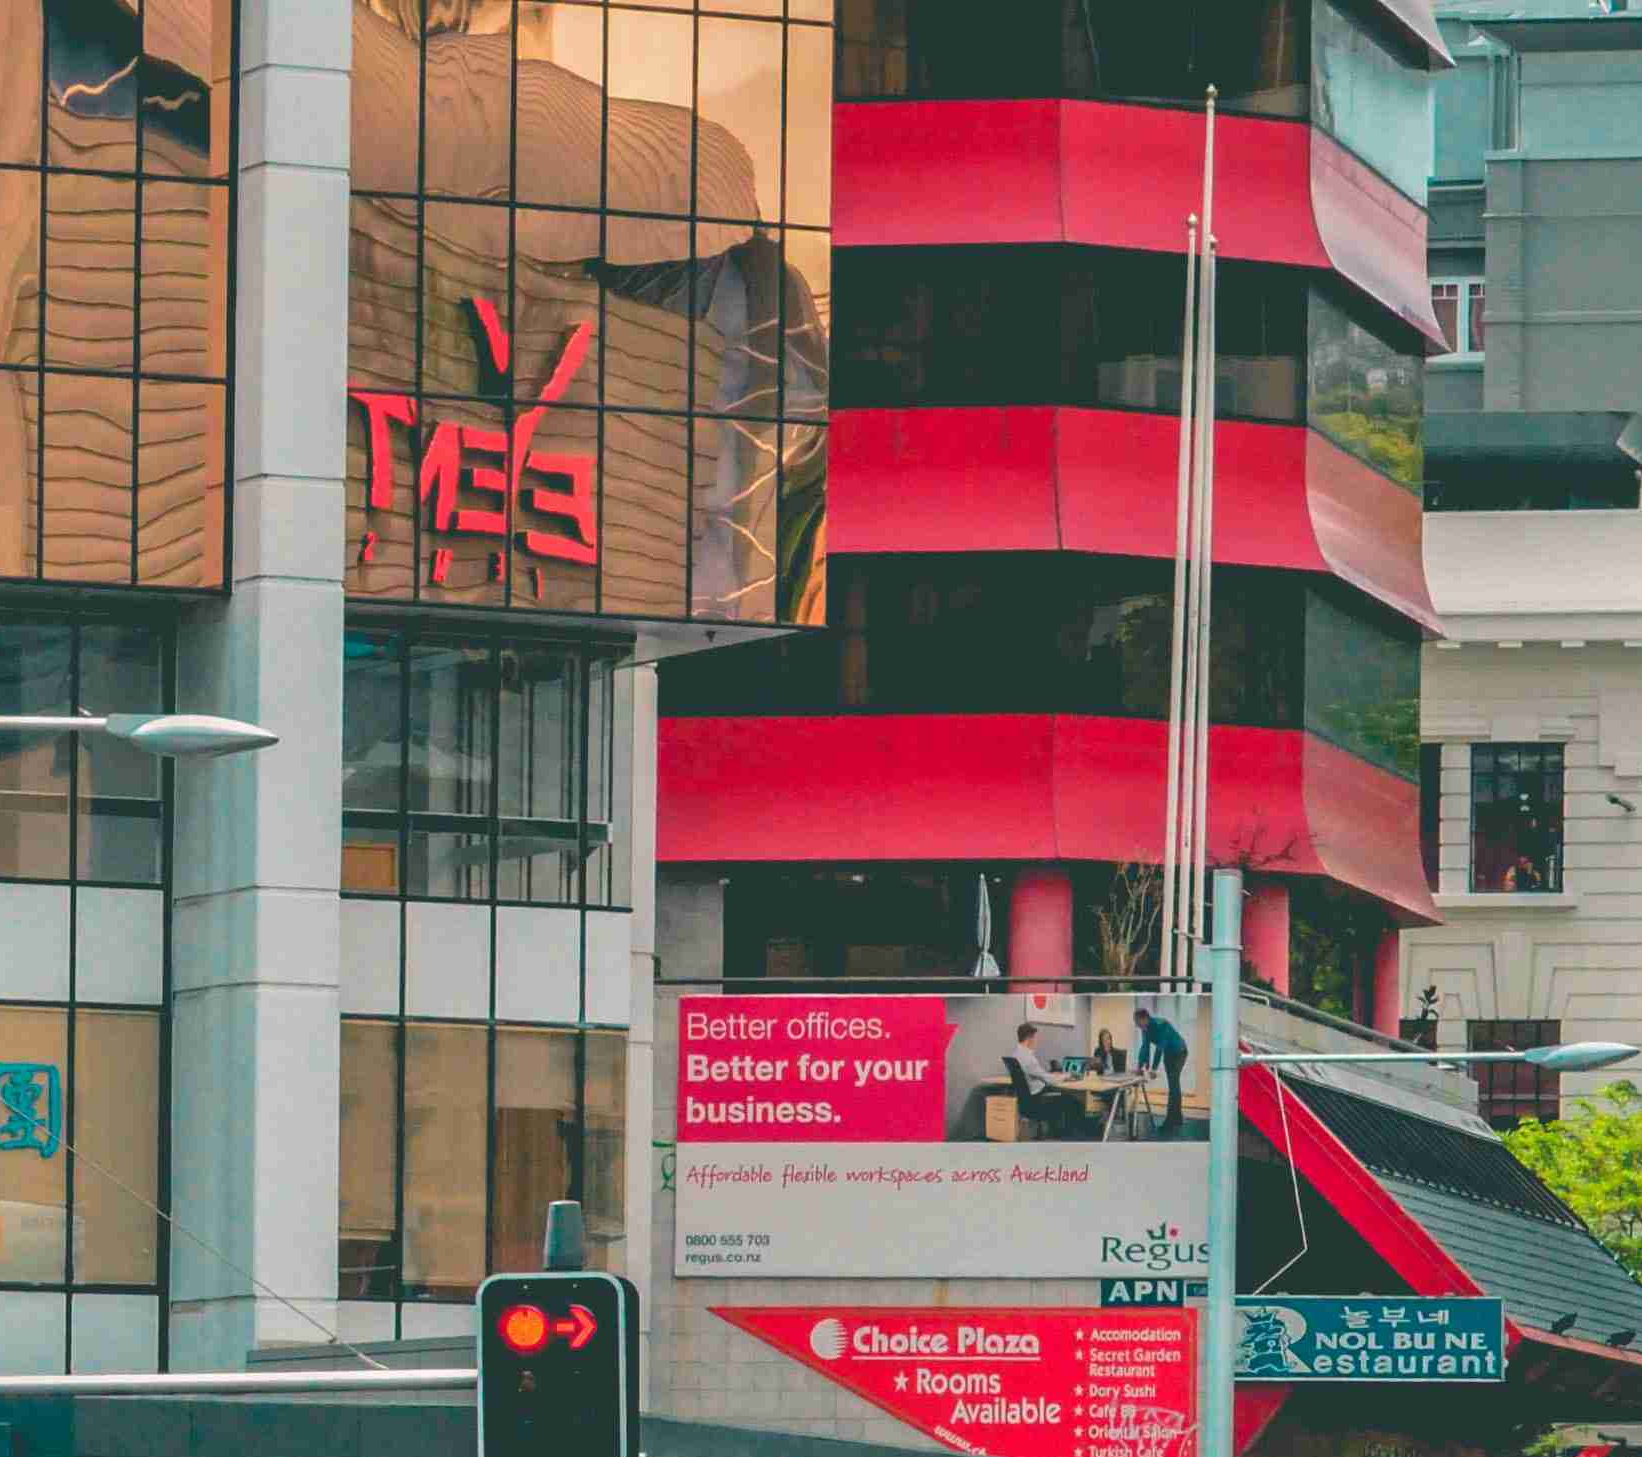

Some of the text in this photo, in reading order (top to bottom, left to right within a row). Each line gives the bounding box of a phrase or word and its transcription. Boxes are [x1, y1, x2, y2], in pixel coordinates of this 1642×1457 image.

[686, 1012, 892, 1040] Better offices.
[685, 1053, 930, 1087] Better for your
[685, 1096, 843, 1124] business.
[685, 1165, 773, 1188] Affordable
[782, 1165, 838, 1188] flexible
[845, 1166, 943, 1190] workspaces
[951, 1169, 1002, 1184] across
[1010, 1166, 1090, 1184] Auckland
[685, 1234, 717, 1247] 0800
[745, 1234, 770, 1247] 703
[685, 1251, 762, 1265] regus.co.nz
[1101, 1235, 1210, 1271] Regus
[1108, 1280, 1179, 1302] APN
[1341, 1306, 1449, 1328] 놀부네
[852, 1326, 1040, 1354] Choice Plaza
[1090, 1328, 1182, 1341] Accomodation
[1315, 1331, 1489, 1352] NOL BU NE
[1090, 1348, 1182, 1362] Secret Garden
[916, 1368, 1001, 1394] Rooms
[1089, 1364, 1155, 1377] Restaurant
[1089, 1383, 1157, 1398] Dory Sushi
[950, 1397, 1062, 1424] Available
